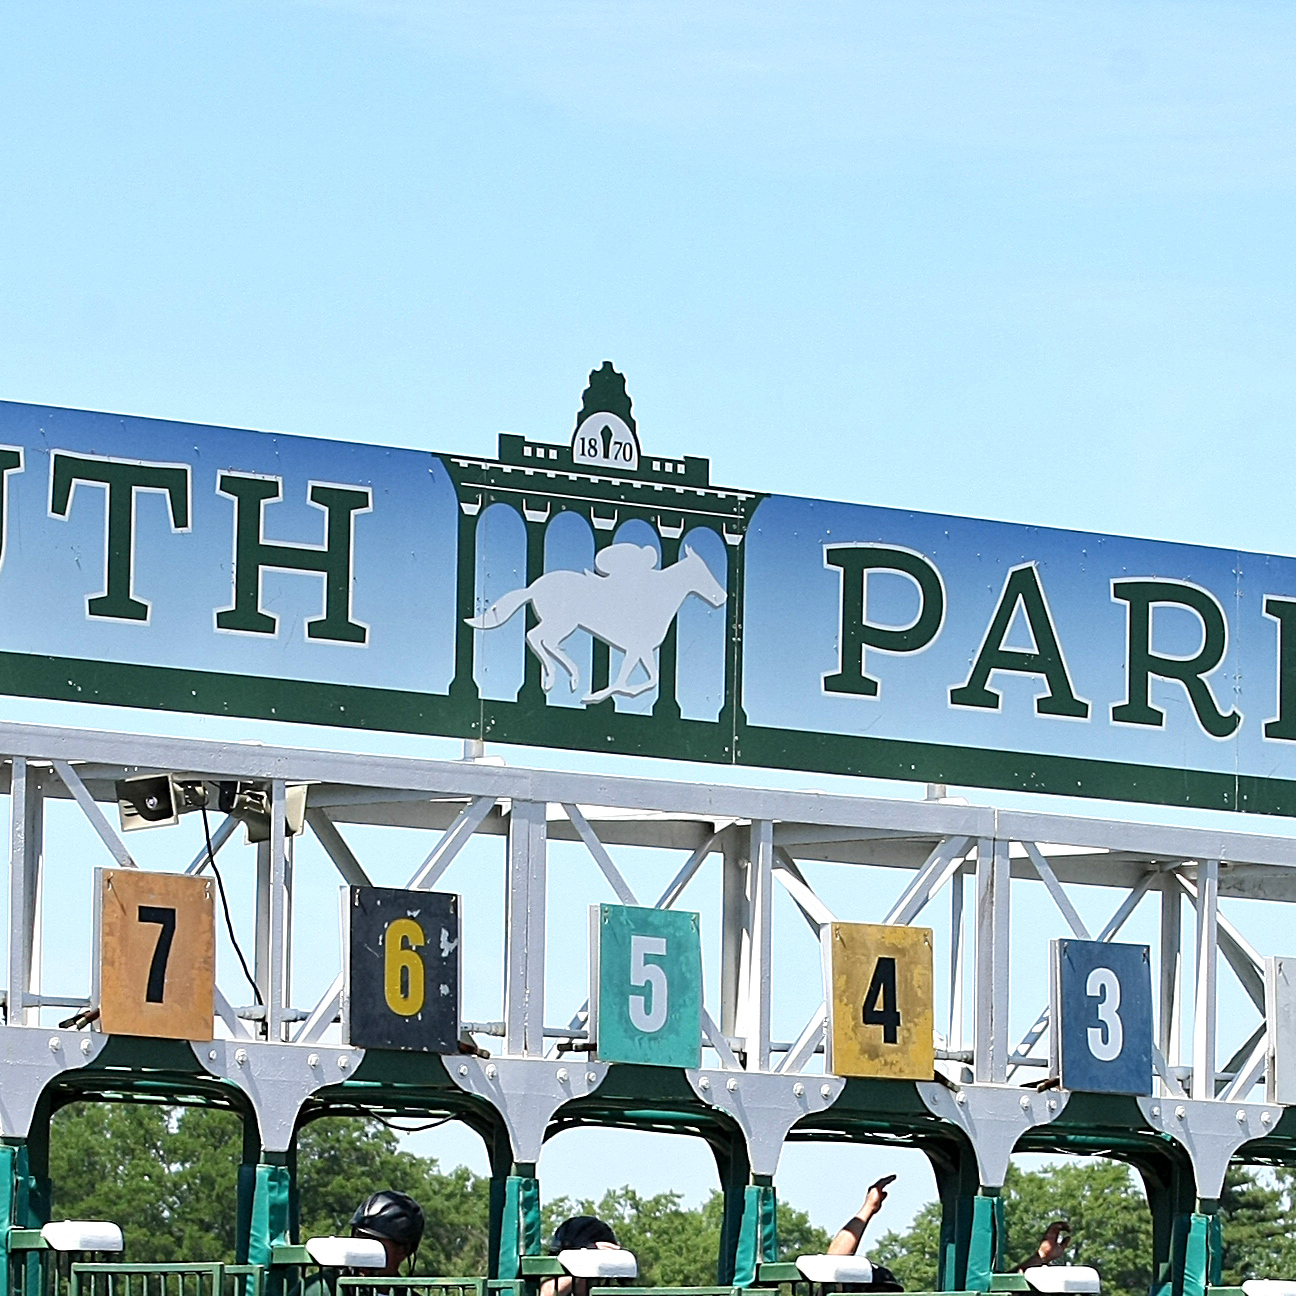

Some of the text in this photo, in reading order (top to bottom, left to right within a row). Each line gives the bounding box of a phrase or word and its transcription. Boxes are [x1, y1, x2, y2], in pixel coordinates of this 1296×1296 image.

[138, 905, 177, 1004] 7
[384, 917, 426, 1016] 6
[628, 935, 668, 1034] 5
[862, 956, 901, 1045] 4
[1085, 967, 1124, 1062] 3
